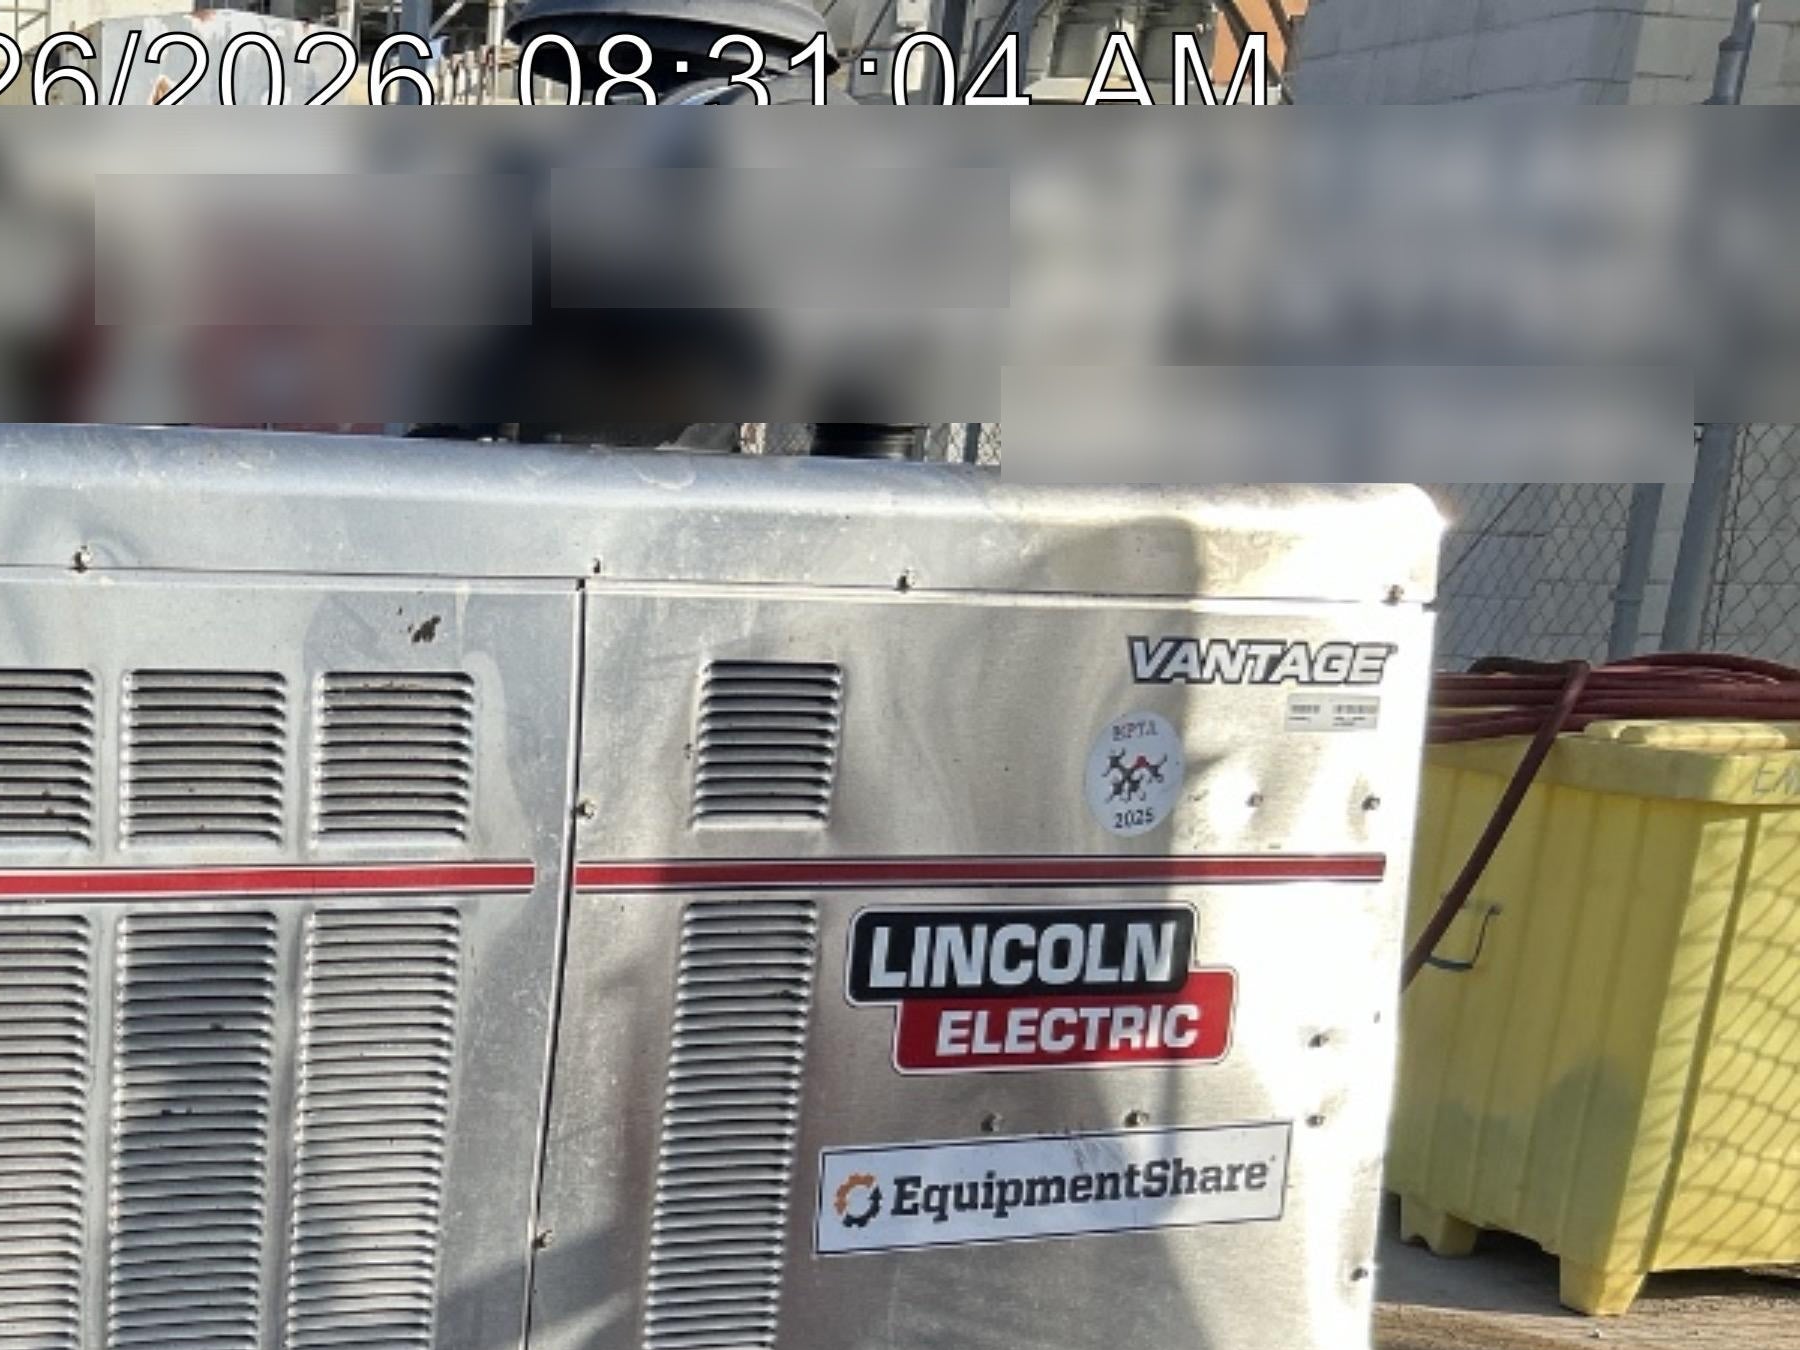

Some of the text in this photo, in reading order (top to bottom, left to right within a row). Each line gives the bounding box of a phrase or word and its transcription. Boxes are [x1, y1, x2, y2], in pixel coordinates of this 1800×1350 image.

[1127, 636, 1390, 684] VANTAGE
[1114, 807, 1155, 829] 2025
[869, 920, 1178, 989] LINCOLN
[935, 1003, 1200, 1057] ELECTRIC
[890, 1157, 1270, 1224] EquipmentShare
